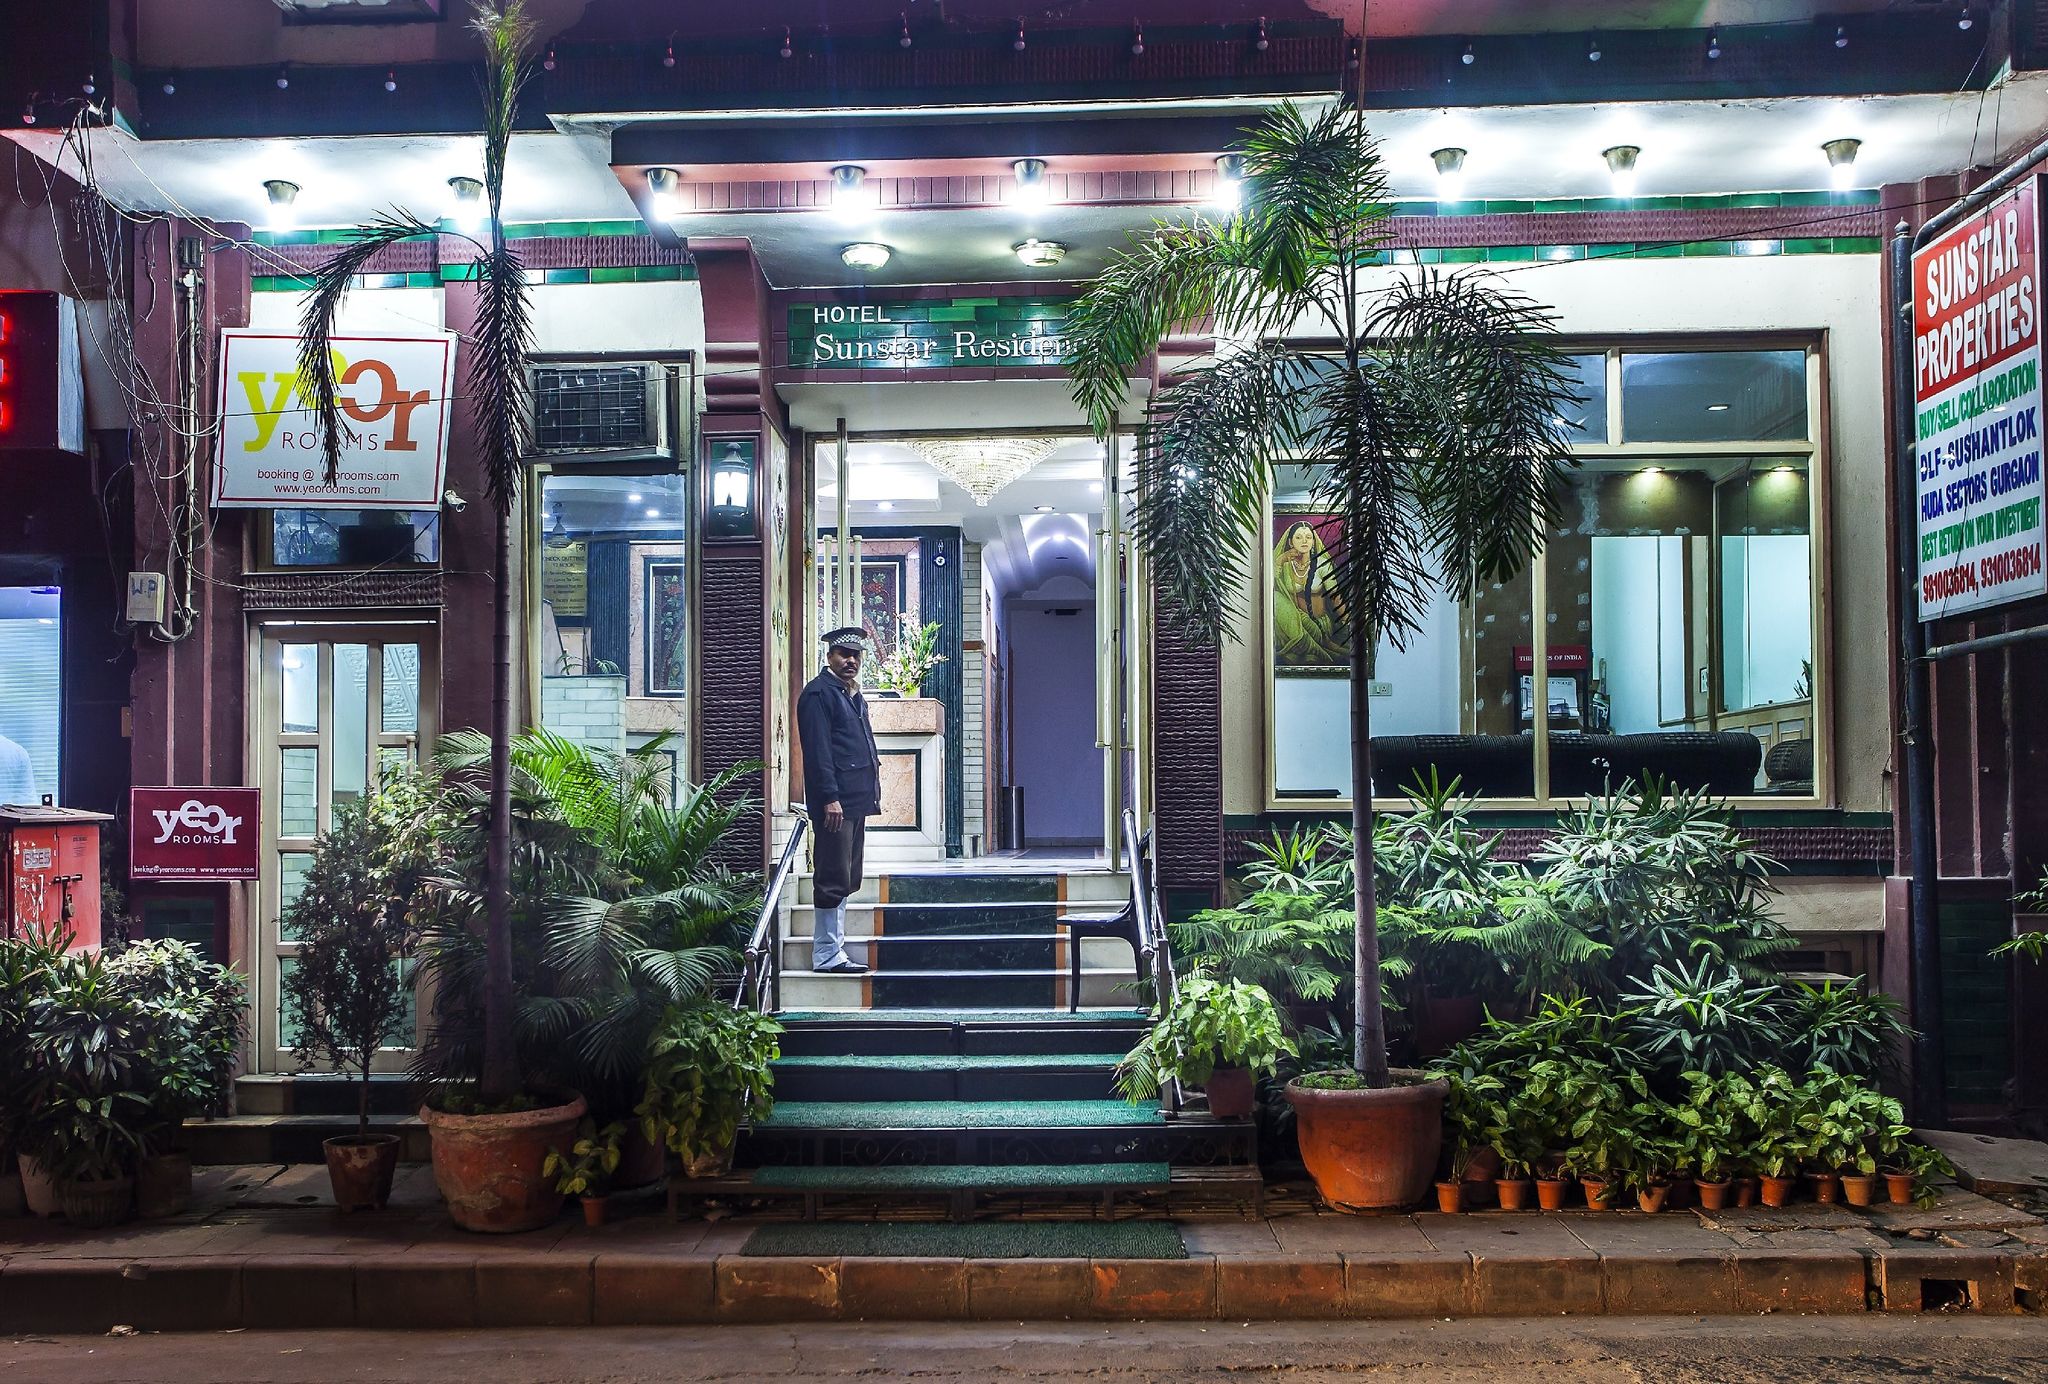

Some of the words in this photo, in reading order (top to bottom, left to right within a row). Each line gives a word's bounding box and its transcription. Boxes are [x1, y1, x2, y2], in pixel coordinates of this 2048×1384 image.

[1926, 209, 2019, 318] SUNSTAR
[814, 306, 891, 323] HOTEL
[814, 333, 938, 361] Sunstar
[1916, 275, 2034, 392] PROPERTIES
[257, 469, 299, 482] booking
[303, 469, 315, 482] @
[274, 484, 381, 495] www.yeorooms.com
[1921, 488, 1944, 522] HUDA
[1946, 471, 1988, 512] SECTORS
[1990, 451, 2039, 497] GURGAON
[1921, 530, 1938, 563] BEST
[1939, 520, 1965, 557] RETURN
[1965, 518, 1975, 549] ON
[1975, 512, 1995, 545] YOUR
[1995, 496, 2040, 540] INVESTMENT
[1980, 542, 2041, 588] 9310036814
[173, 835, 220, 844] ROOMS
